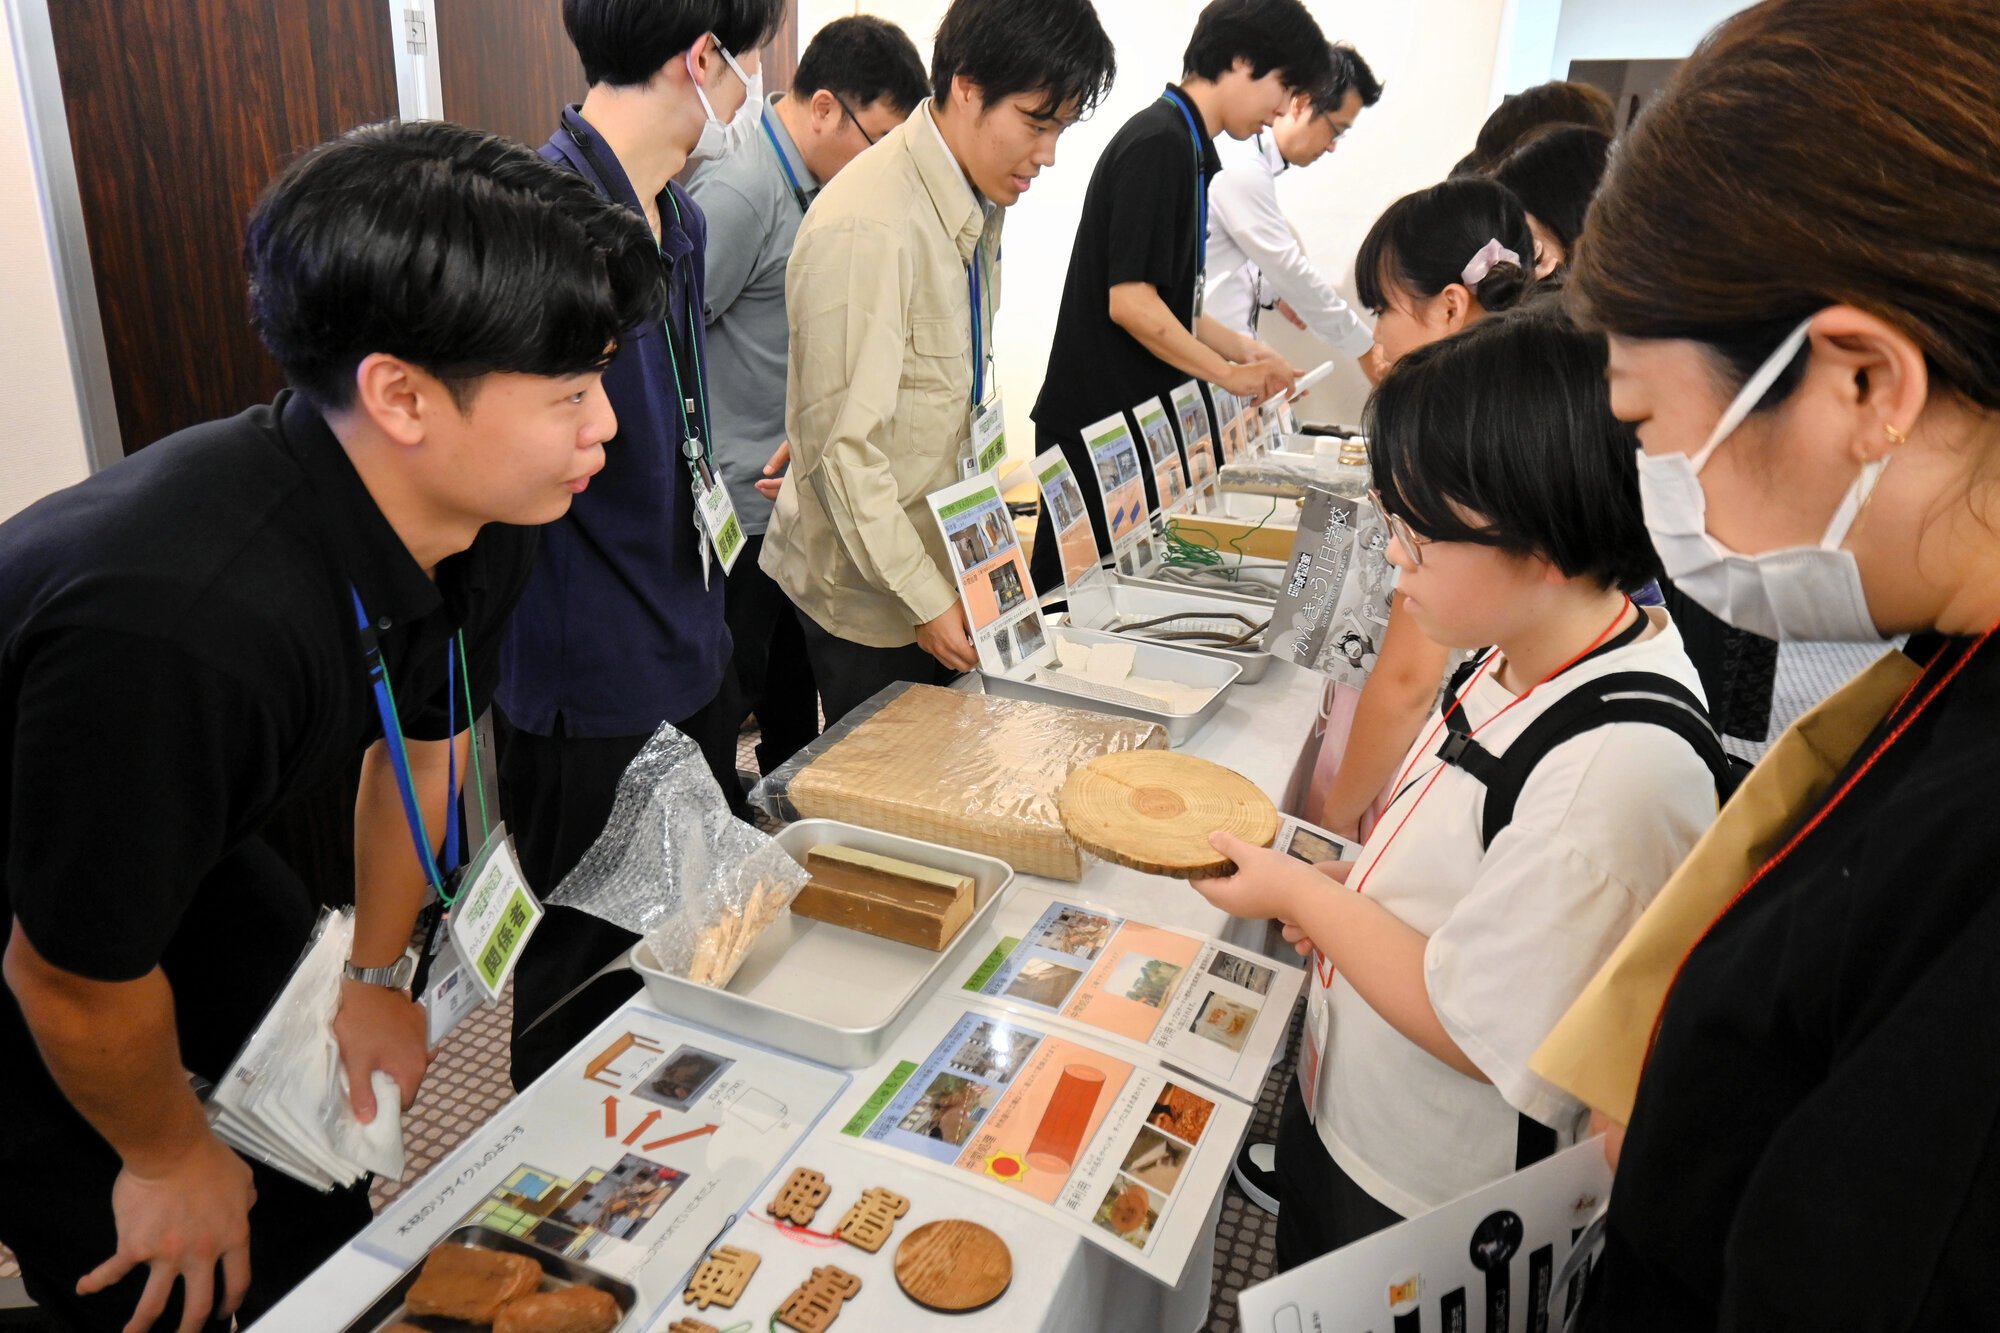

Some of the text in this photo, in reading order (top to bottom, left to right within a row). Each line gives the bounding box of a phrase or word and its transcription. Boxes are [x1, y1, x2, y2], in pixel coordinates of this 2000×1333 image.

[1288, 553, 1312, 598] 地球教室
[1291, 507, 1350, 656] かんきょう1日学校
[482, 900, 527, 979] 関係者
[395, 1123, 526, 1238] 木材のリサイクルのようす
[1064, 1178, 1091, 1211] 再利用
